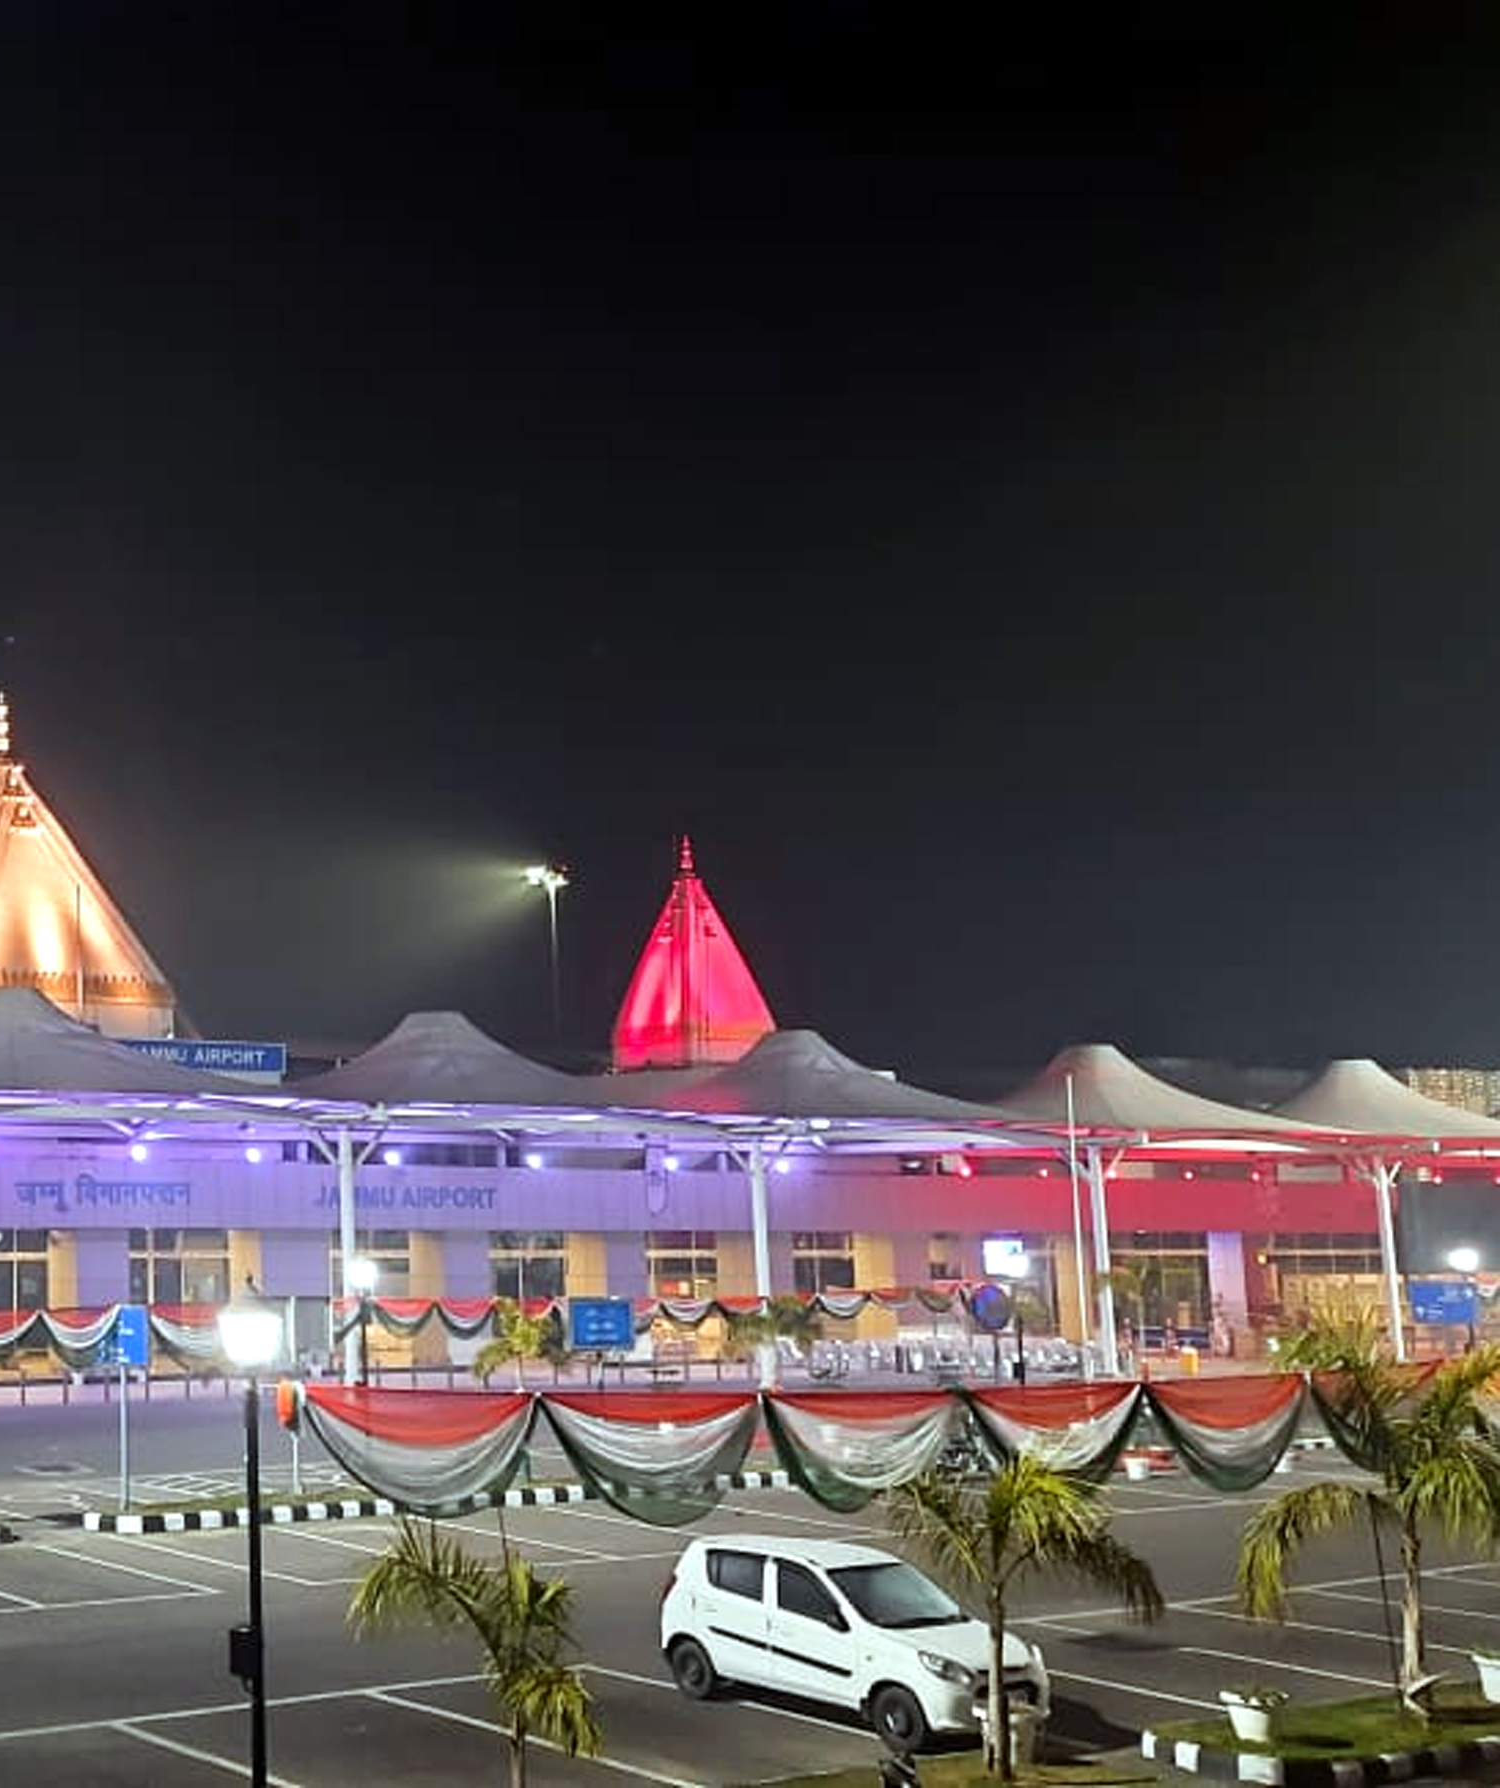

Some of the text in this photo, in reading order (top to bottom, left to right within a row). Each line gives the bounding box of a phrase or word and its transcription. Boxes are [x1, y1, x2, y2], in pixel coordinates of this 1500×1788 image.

[194, 1046, 268, 1067] AIRPORT
[14, 1181, 69, 1212] जम्मू
[402, 1185, 498, 1210] AIRPORT
